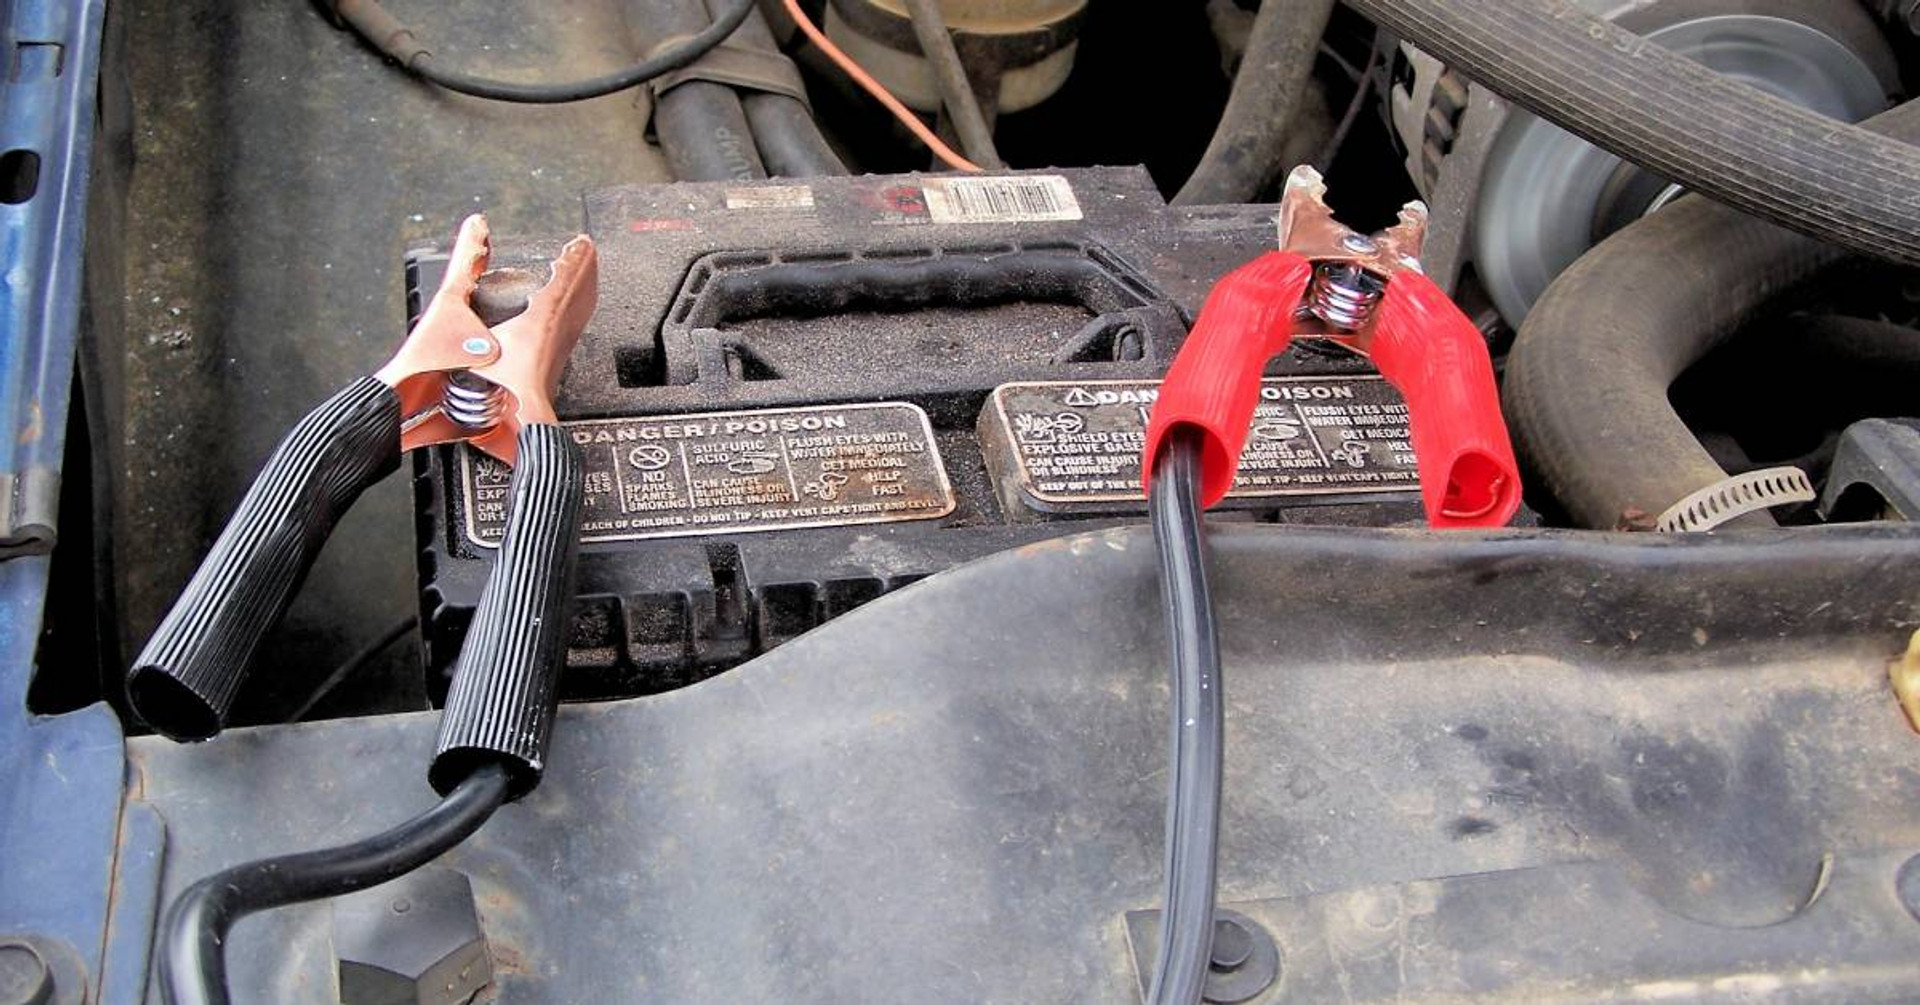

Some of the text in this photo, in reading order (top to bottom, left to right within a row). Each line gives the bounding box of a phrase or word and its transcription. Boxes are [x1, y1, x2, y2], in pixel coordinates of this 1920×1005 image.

[1095, 385, 1354, 404] DAN OISON
[788, 435, 833, 448] FLUSH
[871, 431, 908, 443] WITH
[693, 440, 766, 454] SULFURIC
[1024, 443, 1101, 455] EXPLOSIVE
[642, 472, 665, 483] NO
[693, 478, 718, 489] CAN
[625, 482, 674, 493] SPARKS
[872, 484, 905, 496] FAST
[626, 491, 676, 502] FLAMES
[628, 500, 687, 512] SMOKING
[632, 516, 684, 528] CHILDREN
